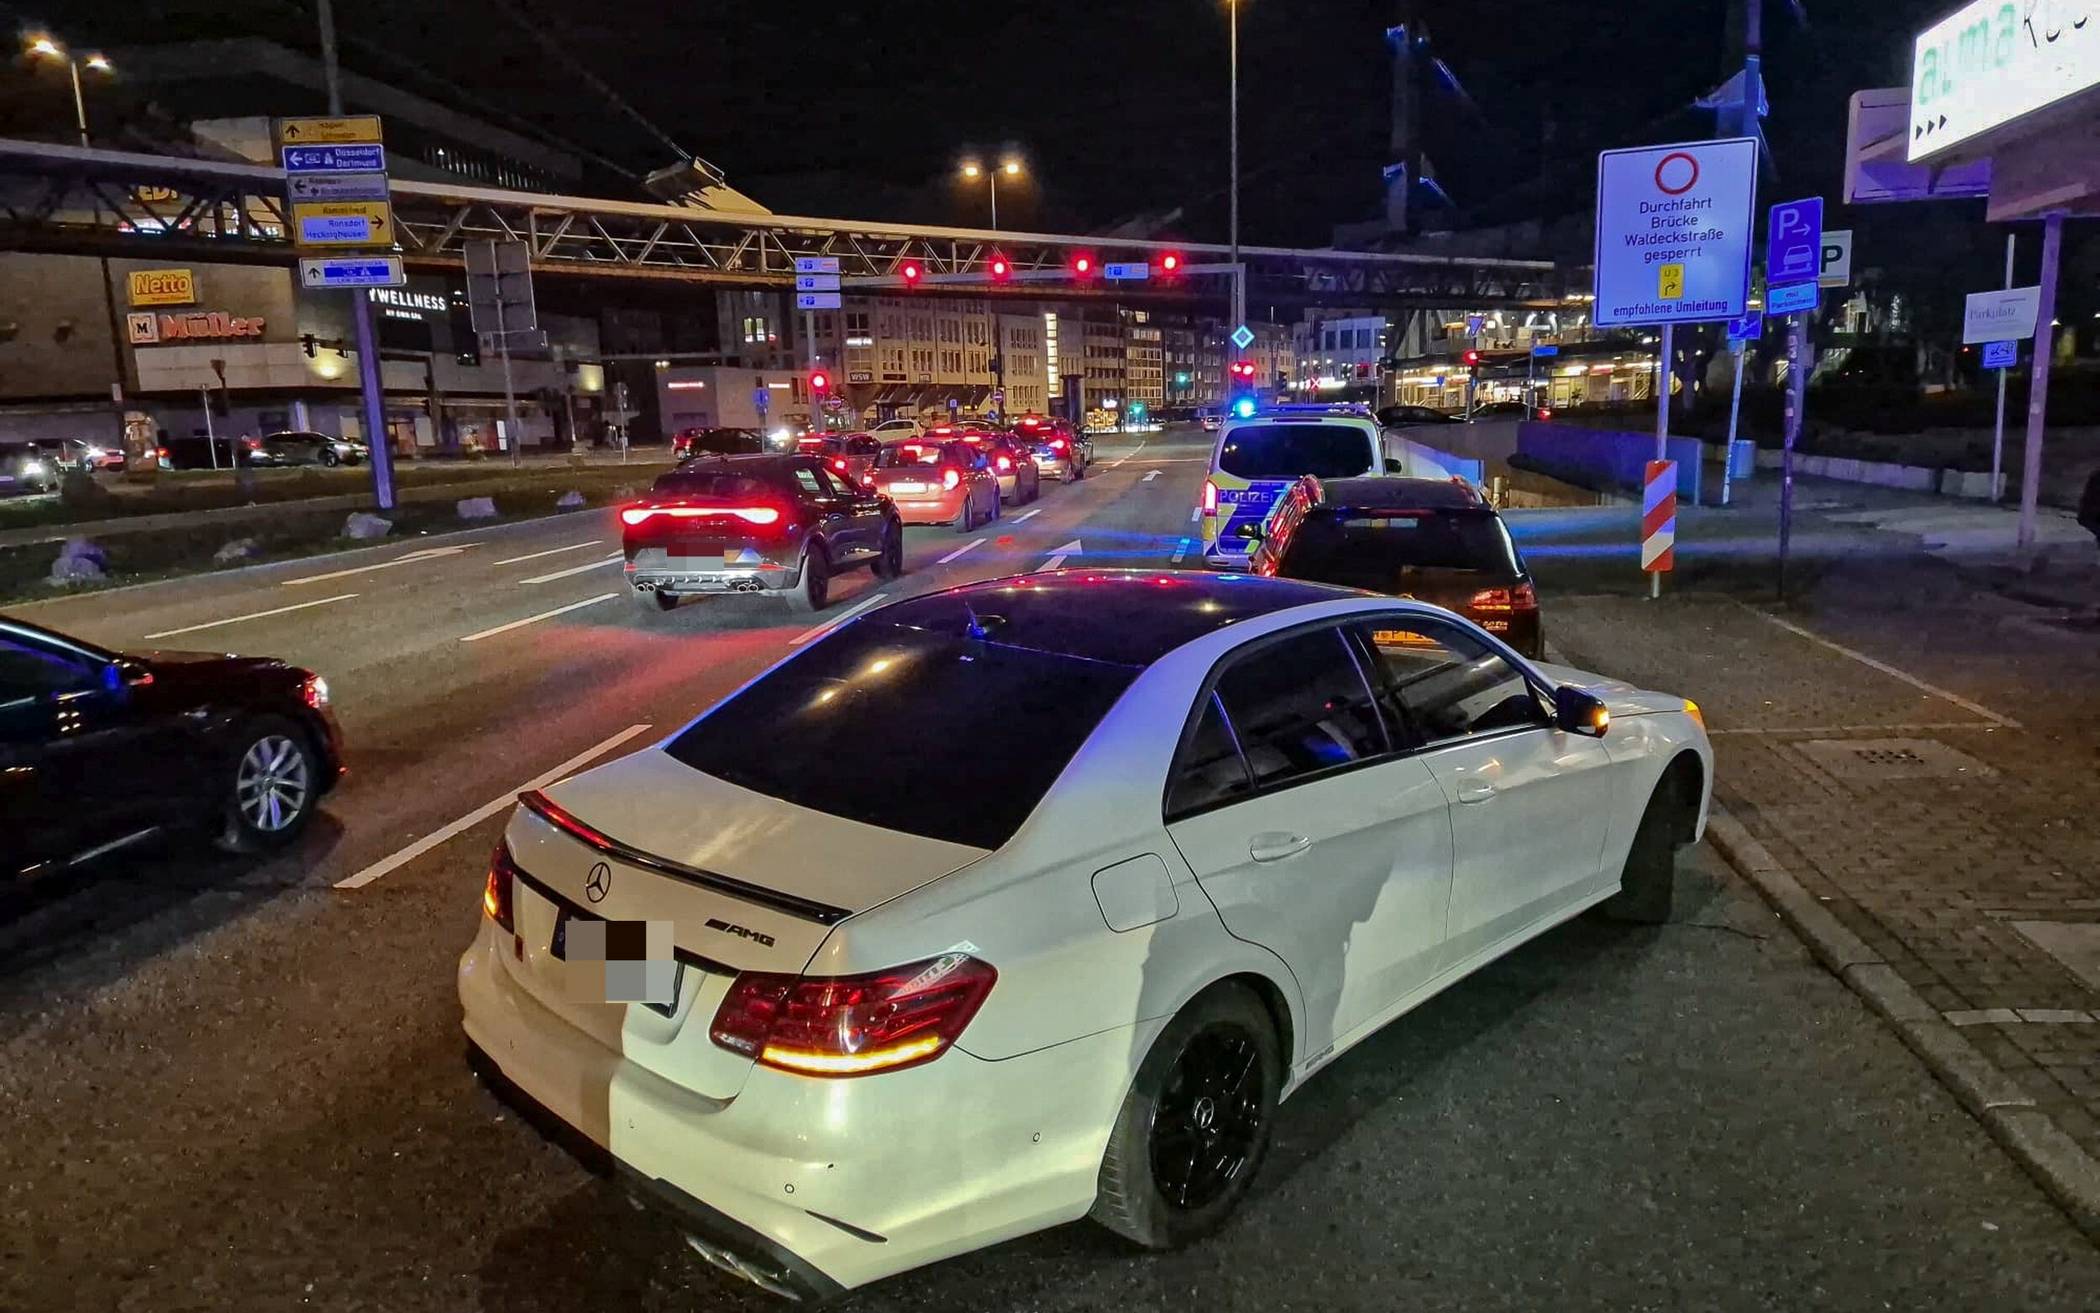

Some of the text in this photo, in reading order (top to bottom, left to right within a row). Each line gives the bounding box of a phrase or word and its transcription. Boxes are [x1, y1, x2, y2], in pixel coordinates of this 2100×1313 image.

[1639, 196, 1712, 214] Durchfahrt
[1651, 216, 1698, 229] Brücke
[1779, 208, 1800, 240] P
[1624, 229, 1724, 247] Waldeckstraße
[1644, 247, 1702, 264] gesperrt
[135, 275, 190, 295] Netto
[1613, 300, 1729, 318] empfohlene Umleitung
[1970, 307, 2016, 320] Parkplatz
[161, 312, 265, 338] Müller
[851, 373, 870, 382] WSW
[726, 925, 776, 948] AMG
